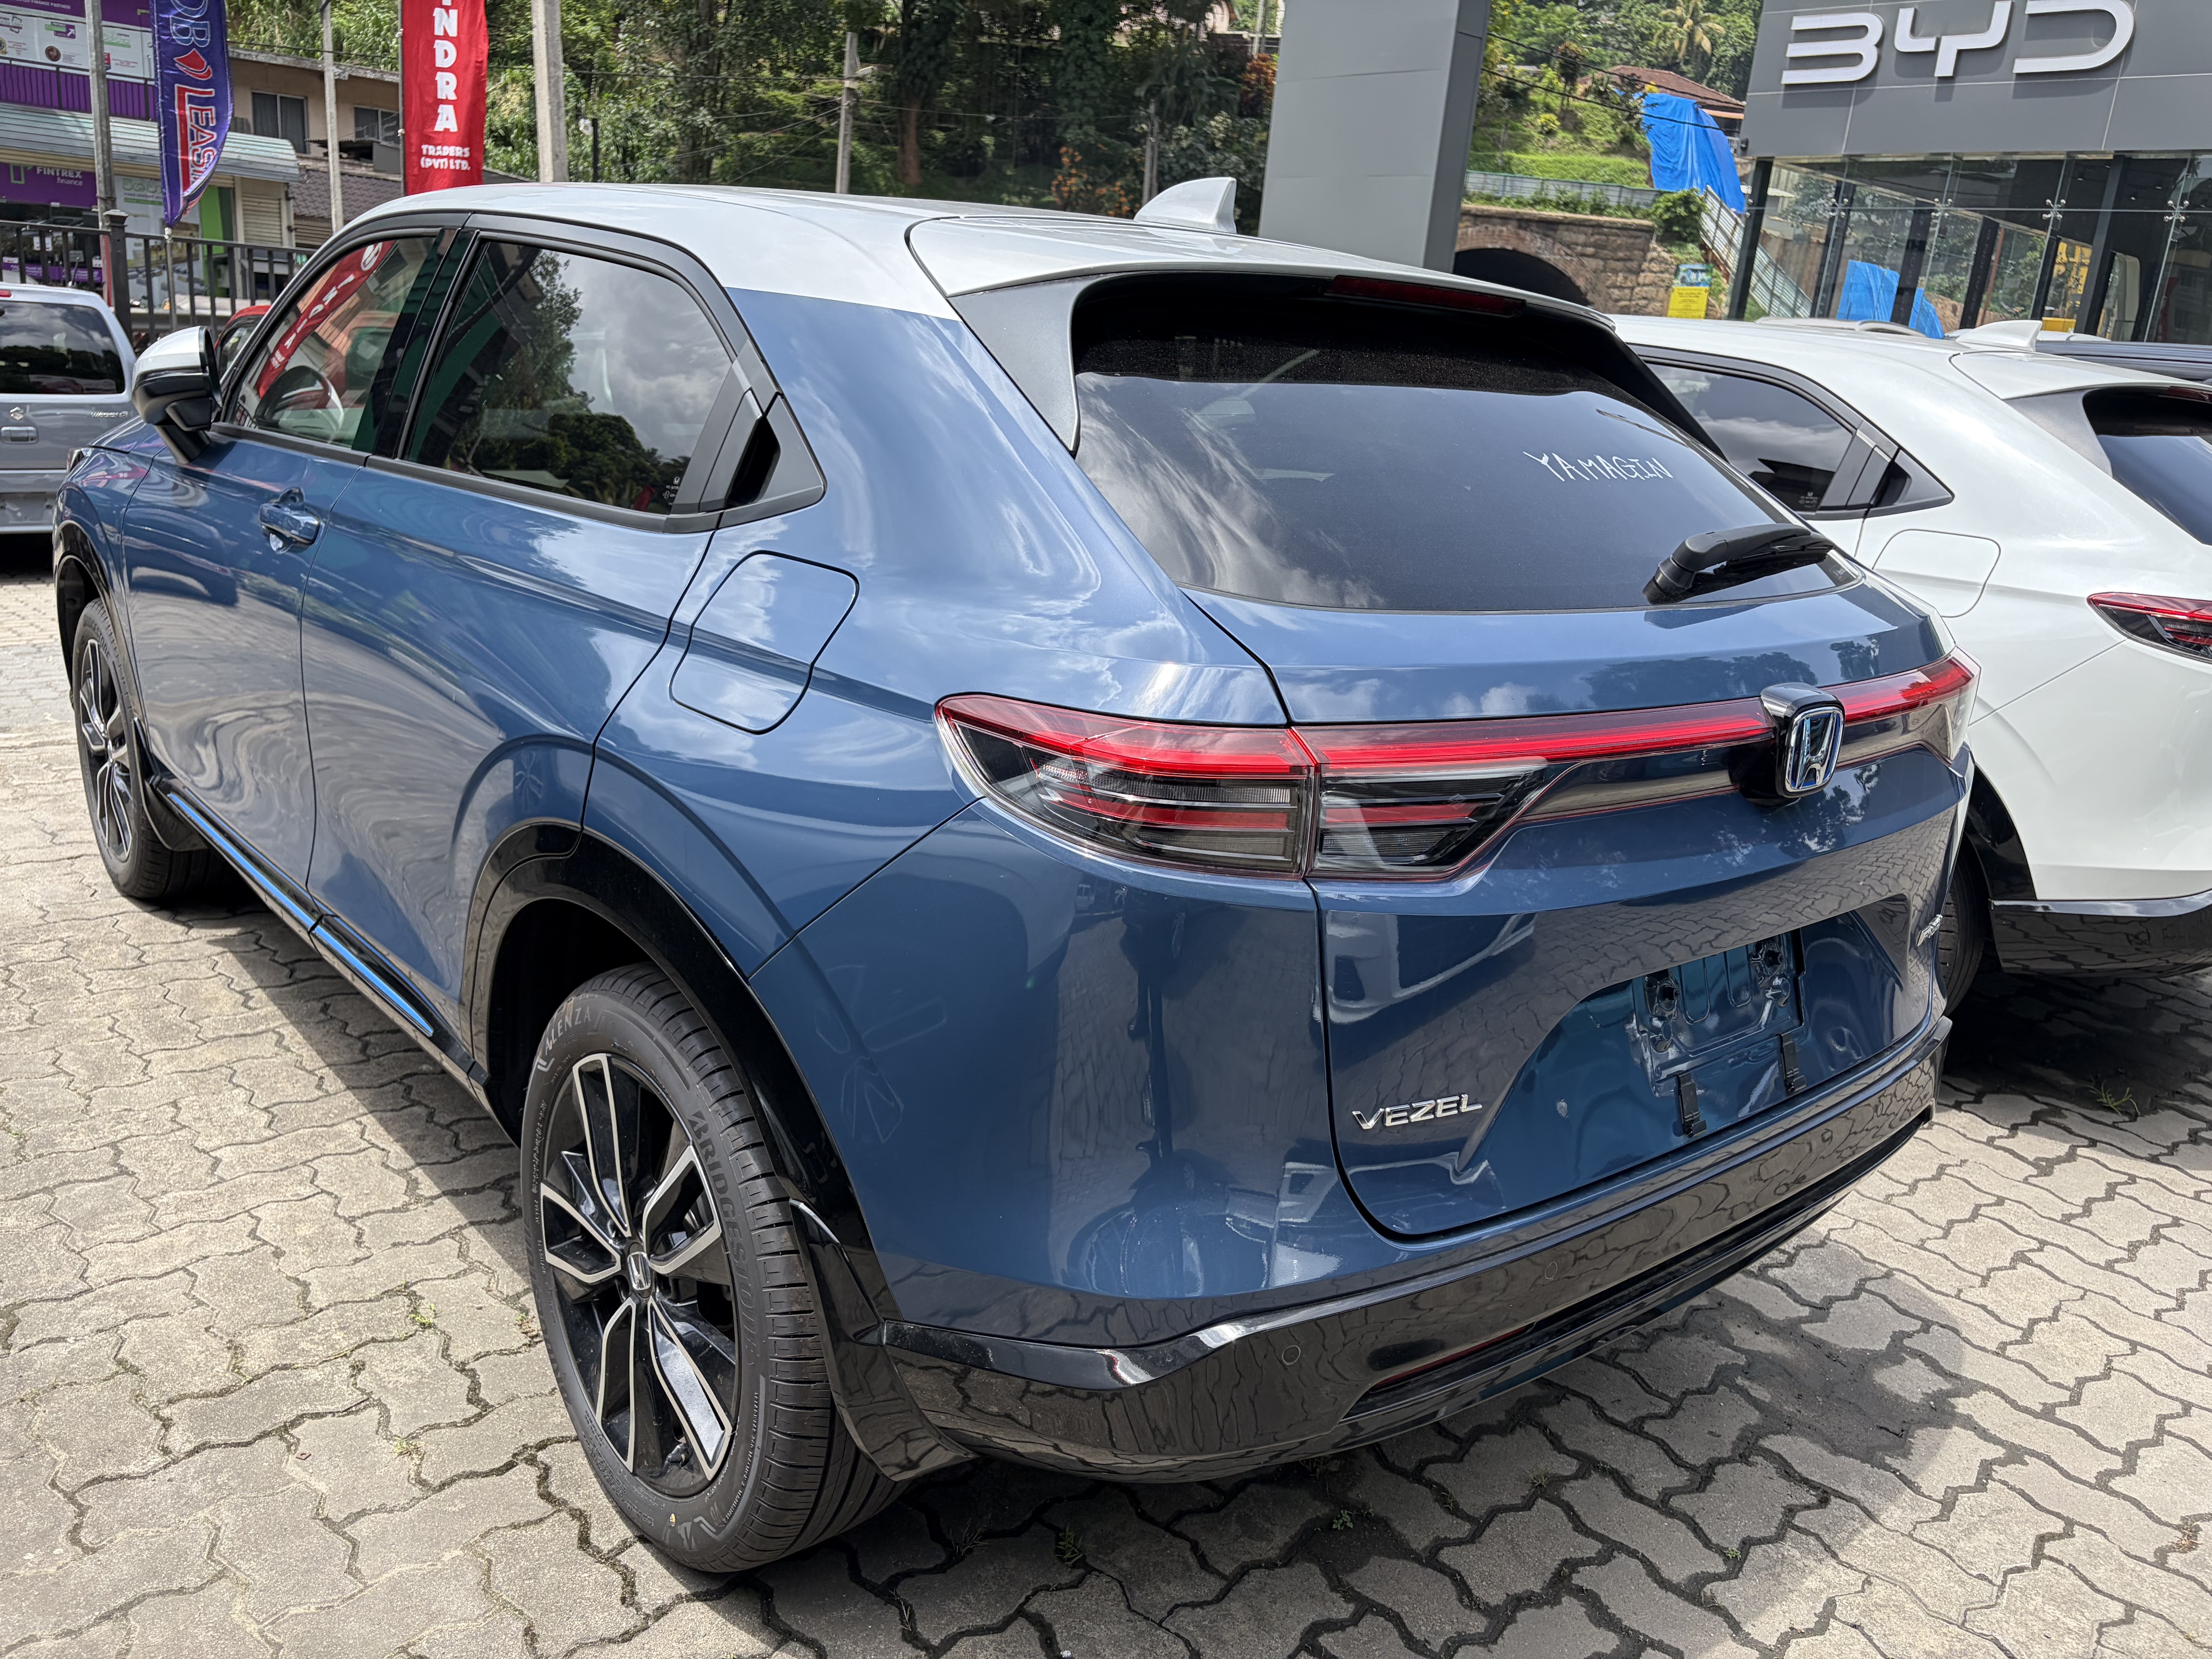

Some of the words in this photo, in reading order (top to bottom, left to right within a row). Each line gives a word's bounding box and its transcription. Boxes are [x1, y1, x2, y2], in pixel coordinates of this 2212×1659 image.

[1781, 0, 2135, 85] BYD
[433, 0, 458, 132] NDRA
[421, 144, 470, 158] TRADERS
[449, 158, 471, 171] LTD.
[36, 166, 82, 179] FINTREX
[57, 177, 83, 186] finance
[1522, 452, 1674, 482] YAMAGIN
[545, 1006, 592, 1056] ALENZA
[1352, 1093, 1483, 1130] VEZEL
[687, 1109, 761, 1357] BRIDGESTONE
